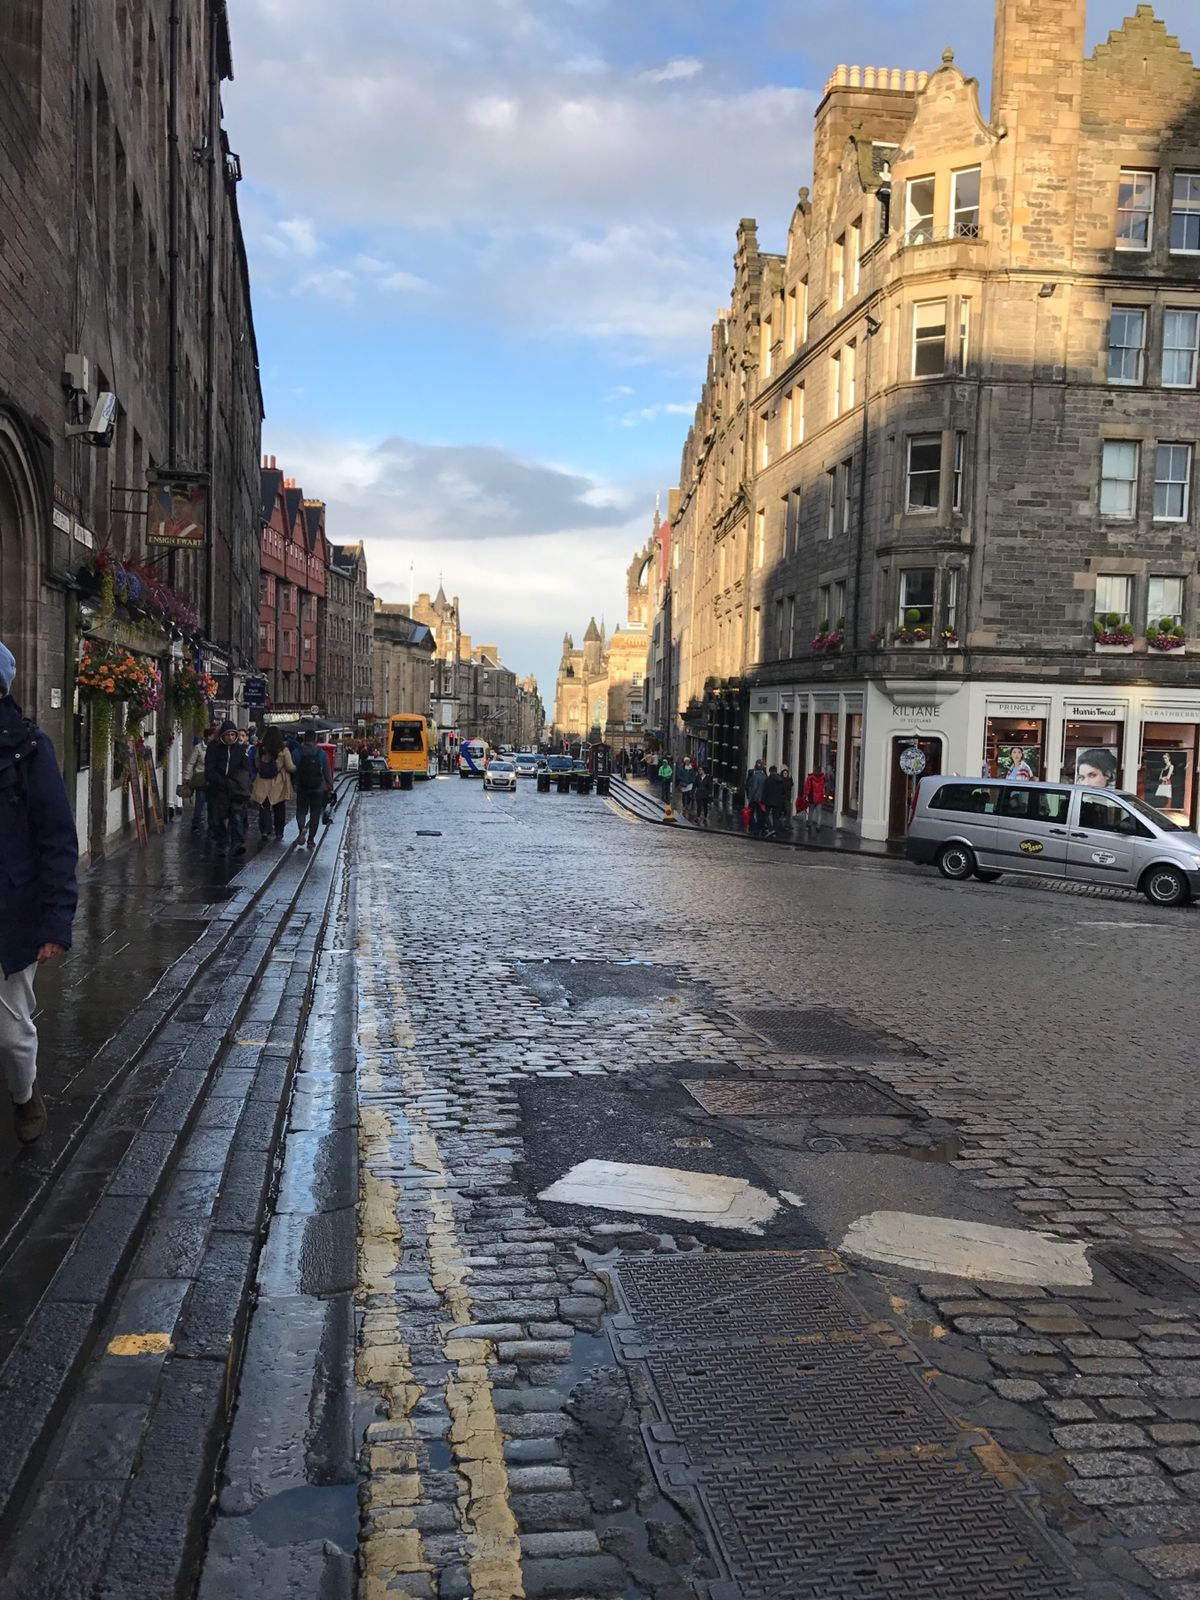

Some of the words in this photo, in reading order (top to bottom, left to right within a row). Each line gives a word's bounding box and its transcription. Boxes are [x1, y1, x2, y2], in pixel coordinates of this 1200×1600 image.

[148, 536, 175, 544] ENSIGN
[892, 705, 940, 717] KILTANE
[1072, 707, 1096, 716] Harris
[1095, 707, 1116, 716] Tweed
[1145, 710, 1199, 718] STRATHBERRY
